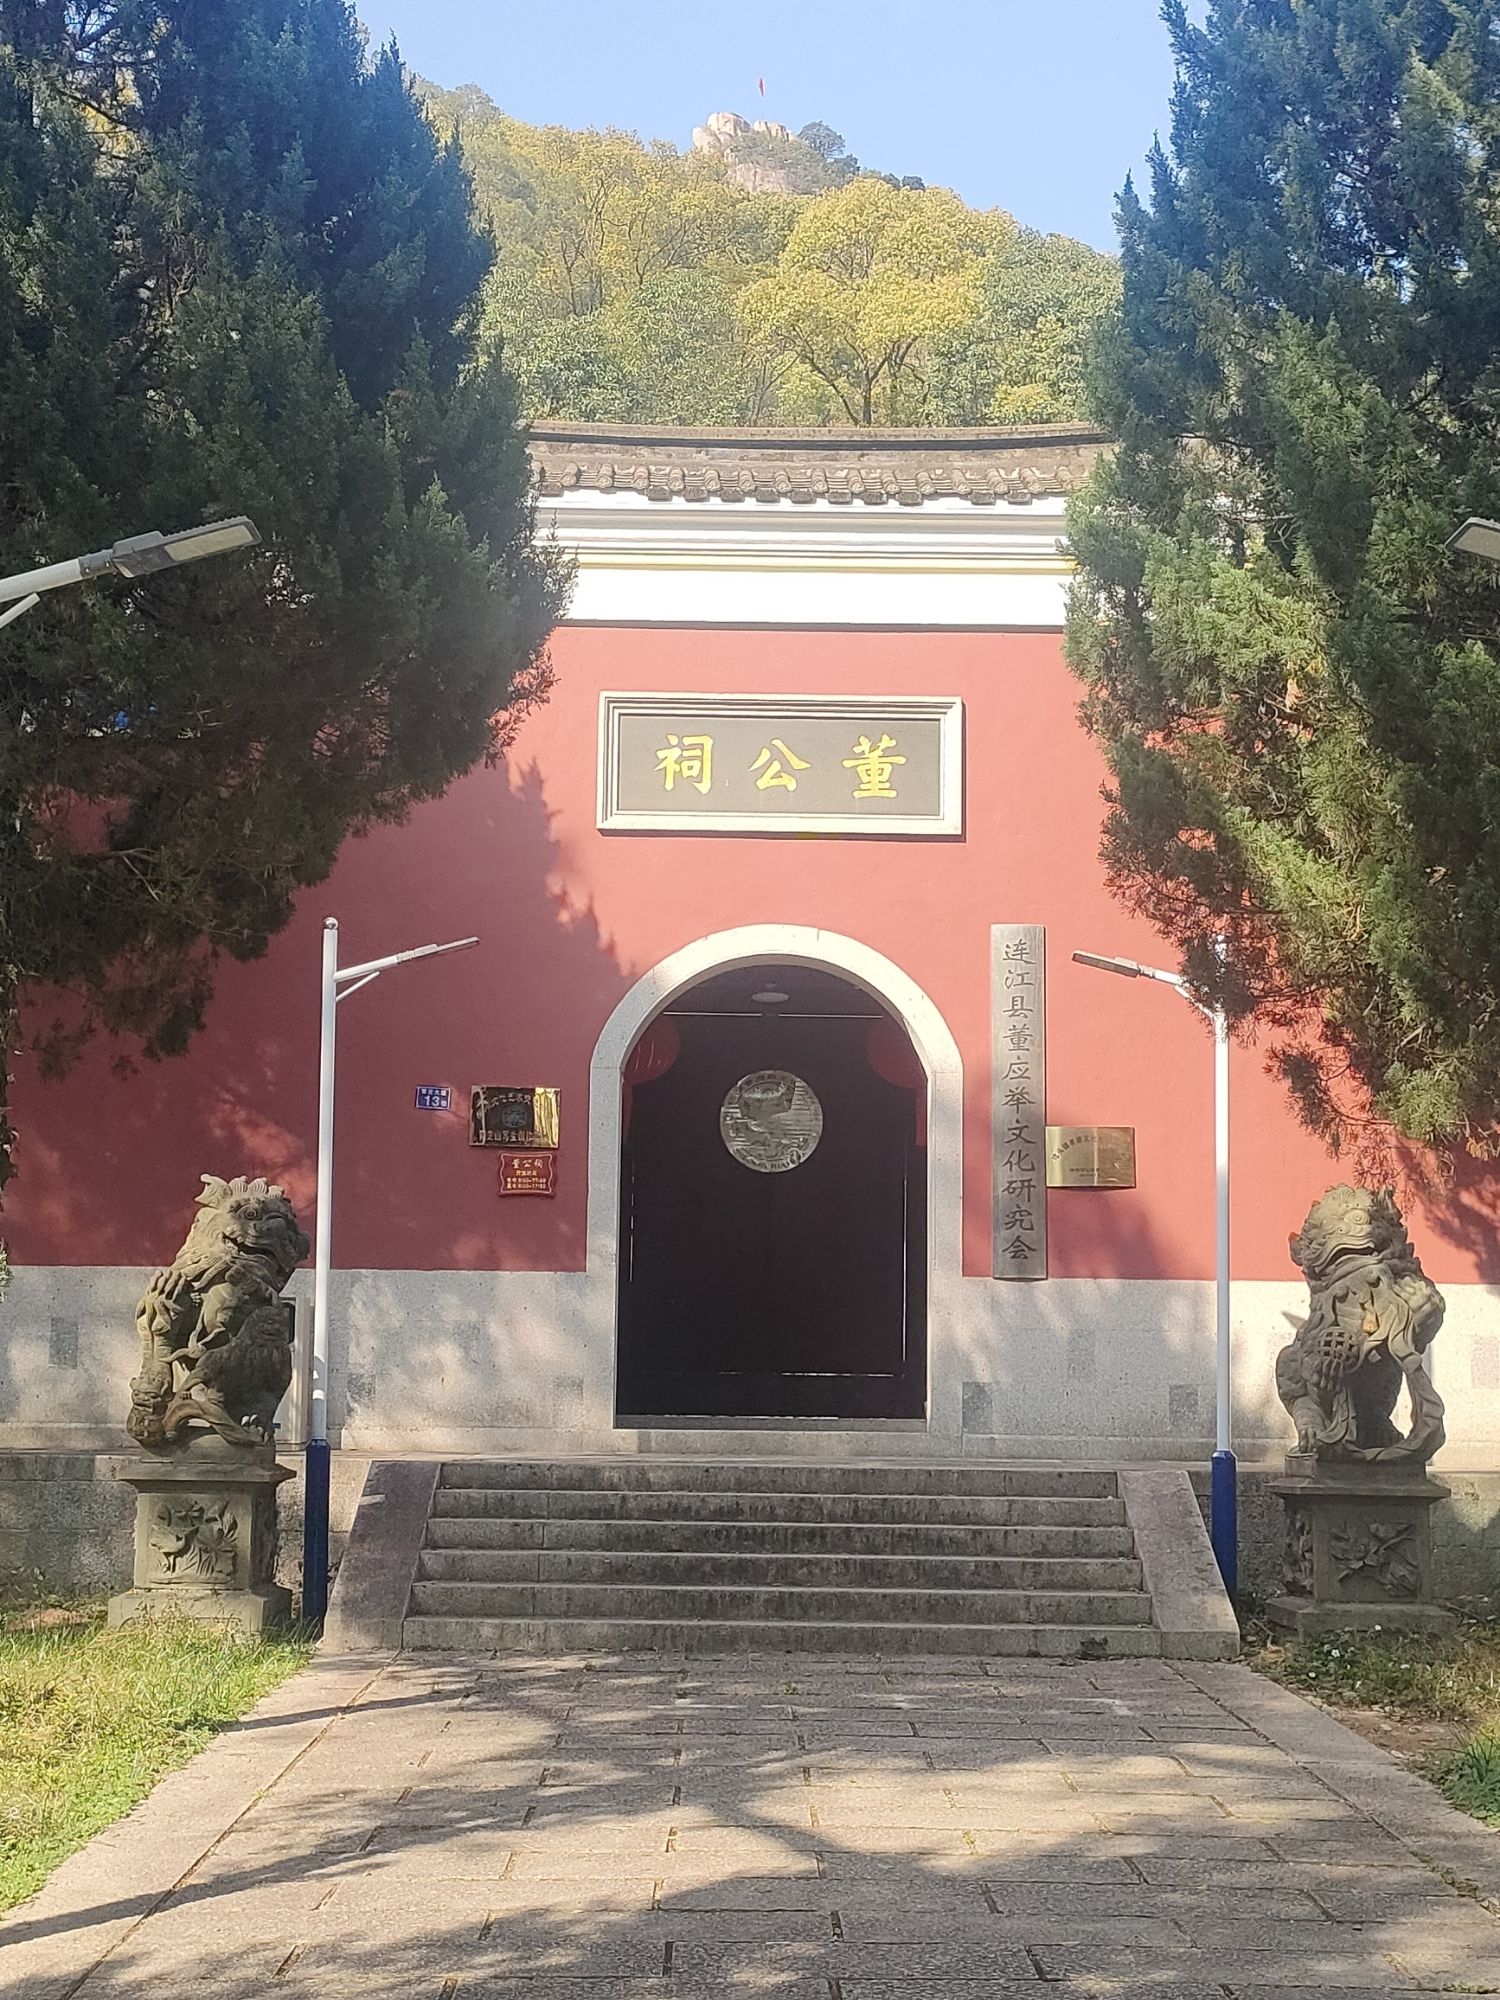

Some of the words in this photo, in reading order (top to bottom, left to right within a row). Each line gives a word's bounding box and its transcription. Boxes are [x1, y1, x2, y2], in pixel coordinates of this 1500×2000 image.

[653, 732, 908, 800] 董公祠
[1001, 938, 1037, 1260] 连江县董应举文化研究会
